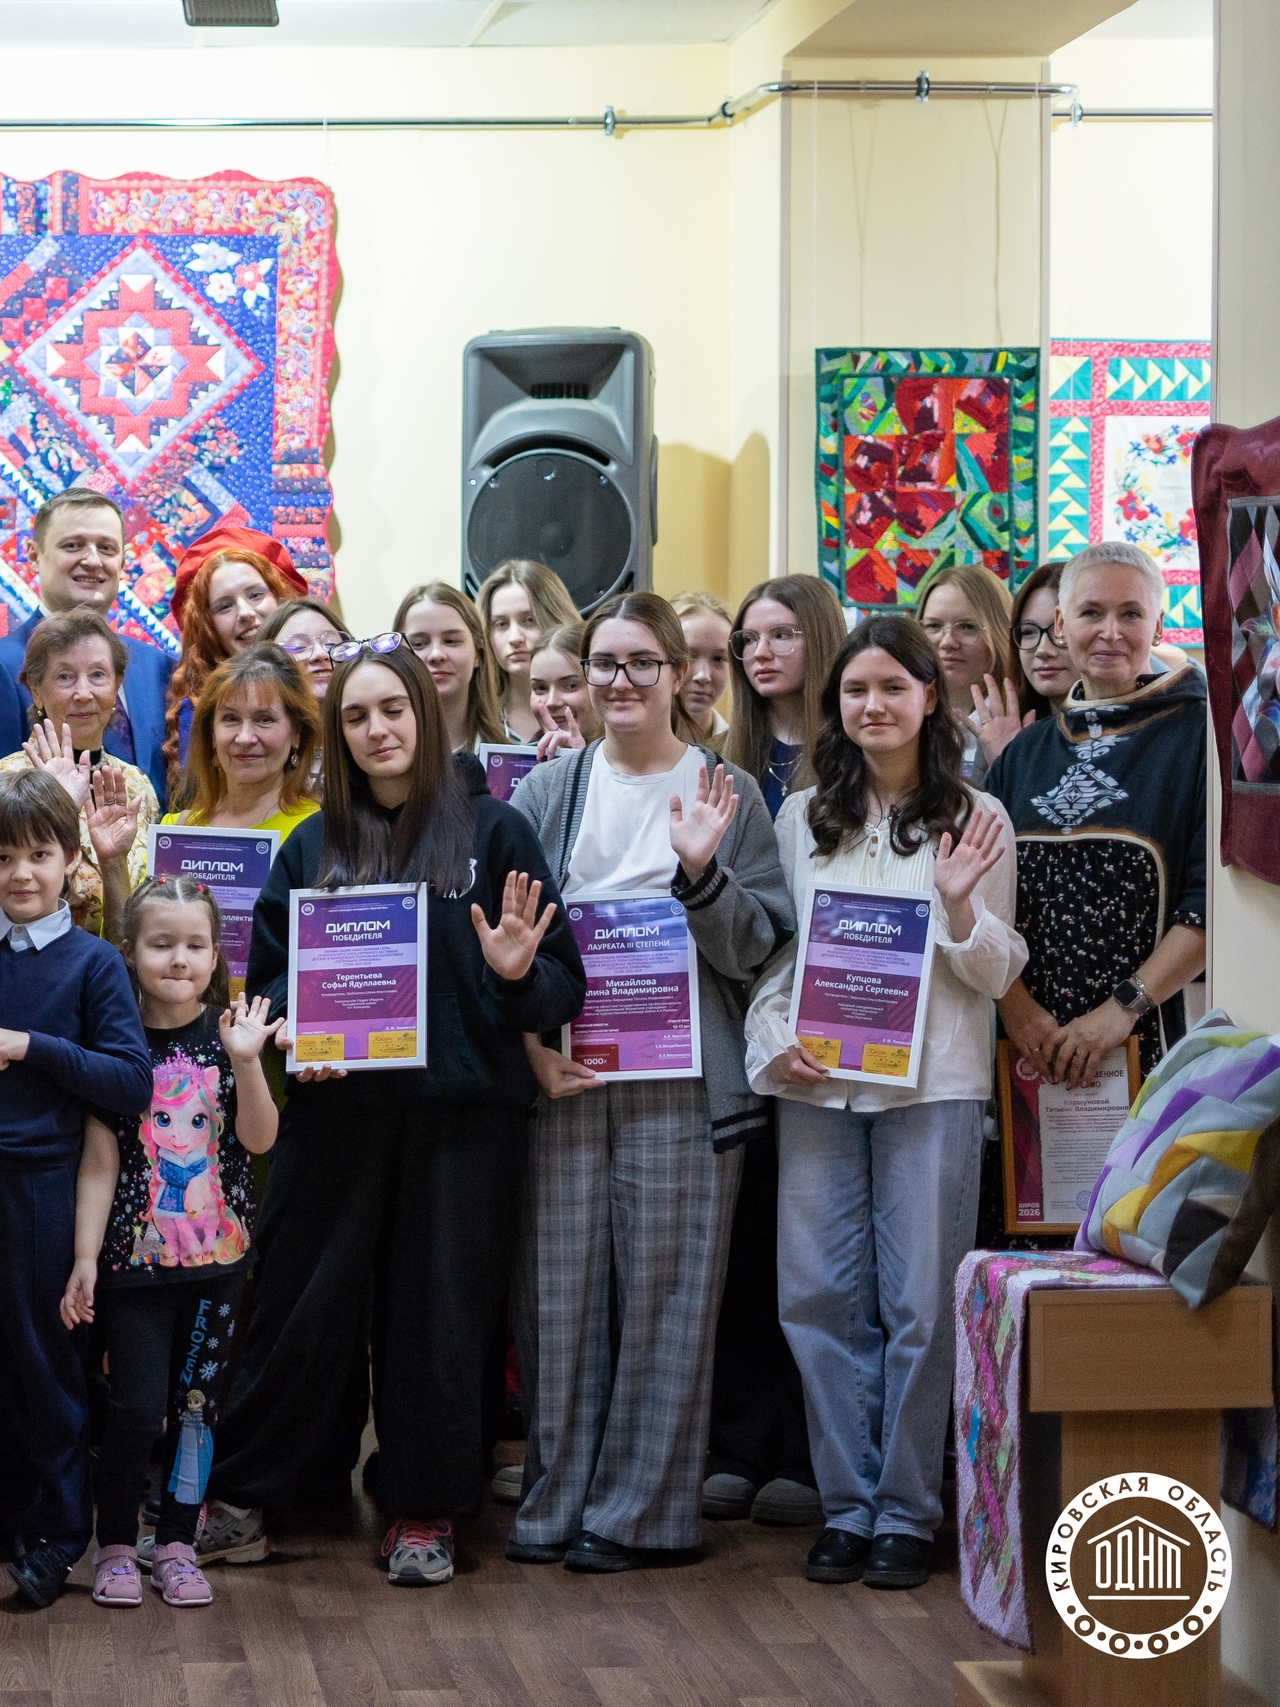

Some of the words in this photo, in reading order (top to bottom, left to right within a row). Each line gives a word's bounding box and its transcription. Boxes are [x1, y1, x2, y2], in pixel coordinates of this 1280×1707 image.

[181, 860, 243, 872] ДИПЛОМ
[325, 920, 389, 932] ДИПЛОМ
[838, 919, 900, 935] ДИПЛОМ
[332, 933, 381, 941] ПОБЕДИТЕЛЯ
[594, 925, 658, 939] ДИПЛОМ
[843, 932, 891, 944] ПОБЕДИТЕЛЯ
[587, 942, 624, 950] ЛАУРЕАТА
[635, 939, 669, 947] СТЕПЕНИ
[336, 972, 381, 981] Терентьева
[606, 977, 656, 987] Михайлова
[846, 974, 881, 985] Купцова
[322, 981, 346, 989] Софья
[349, 979, 395, 988] Ядуллаевна
[612, 984, 678, 995] Владимировна
[814, 979, 862, 992] Александра
[865, 985, 908, 997] Сергеевна
[180, 1299, 211, 1388] FROZEN
